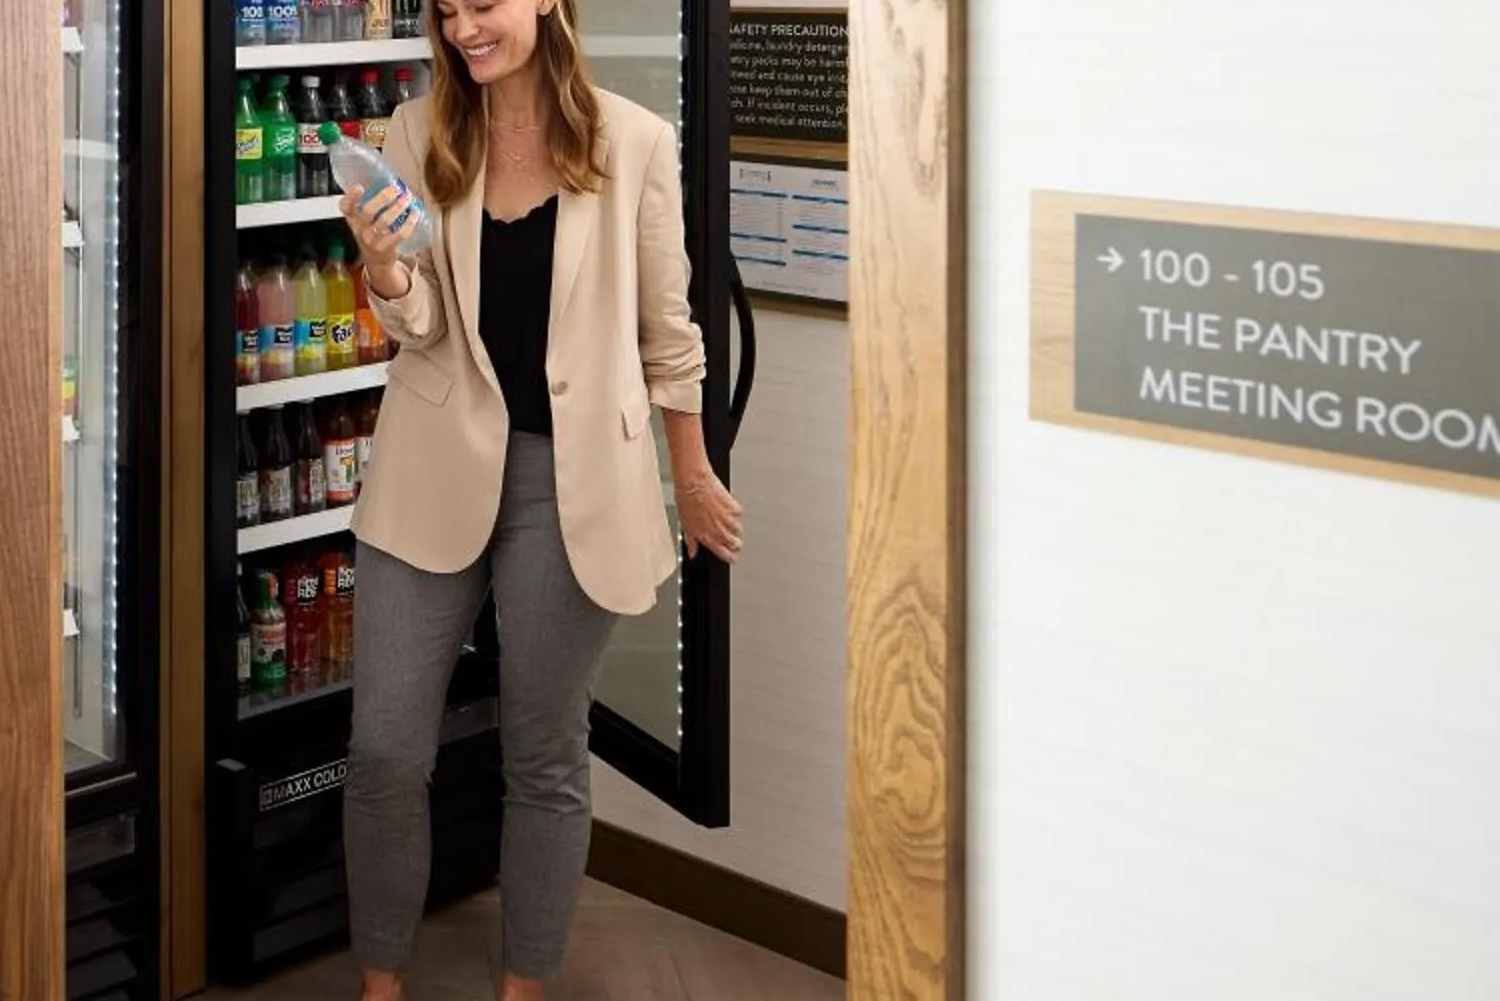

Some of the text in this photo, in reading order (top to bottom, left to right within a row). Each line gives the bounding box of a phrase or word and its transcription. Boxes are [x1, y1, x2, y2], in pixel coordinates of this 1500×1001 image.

[1139, 248, 1211, 287] 100
[1251, 259, 1326, 301] 105
[1139, 306, 1423, 375] THE PANTRY
[1138, 366, 1344, 429] MEETING
